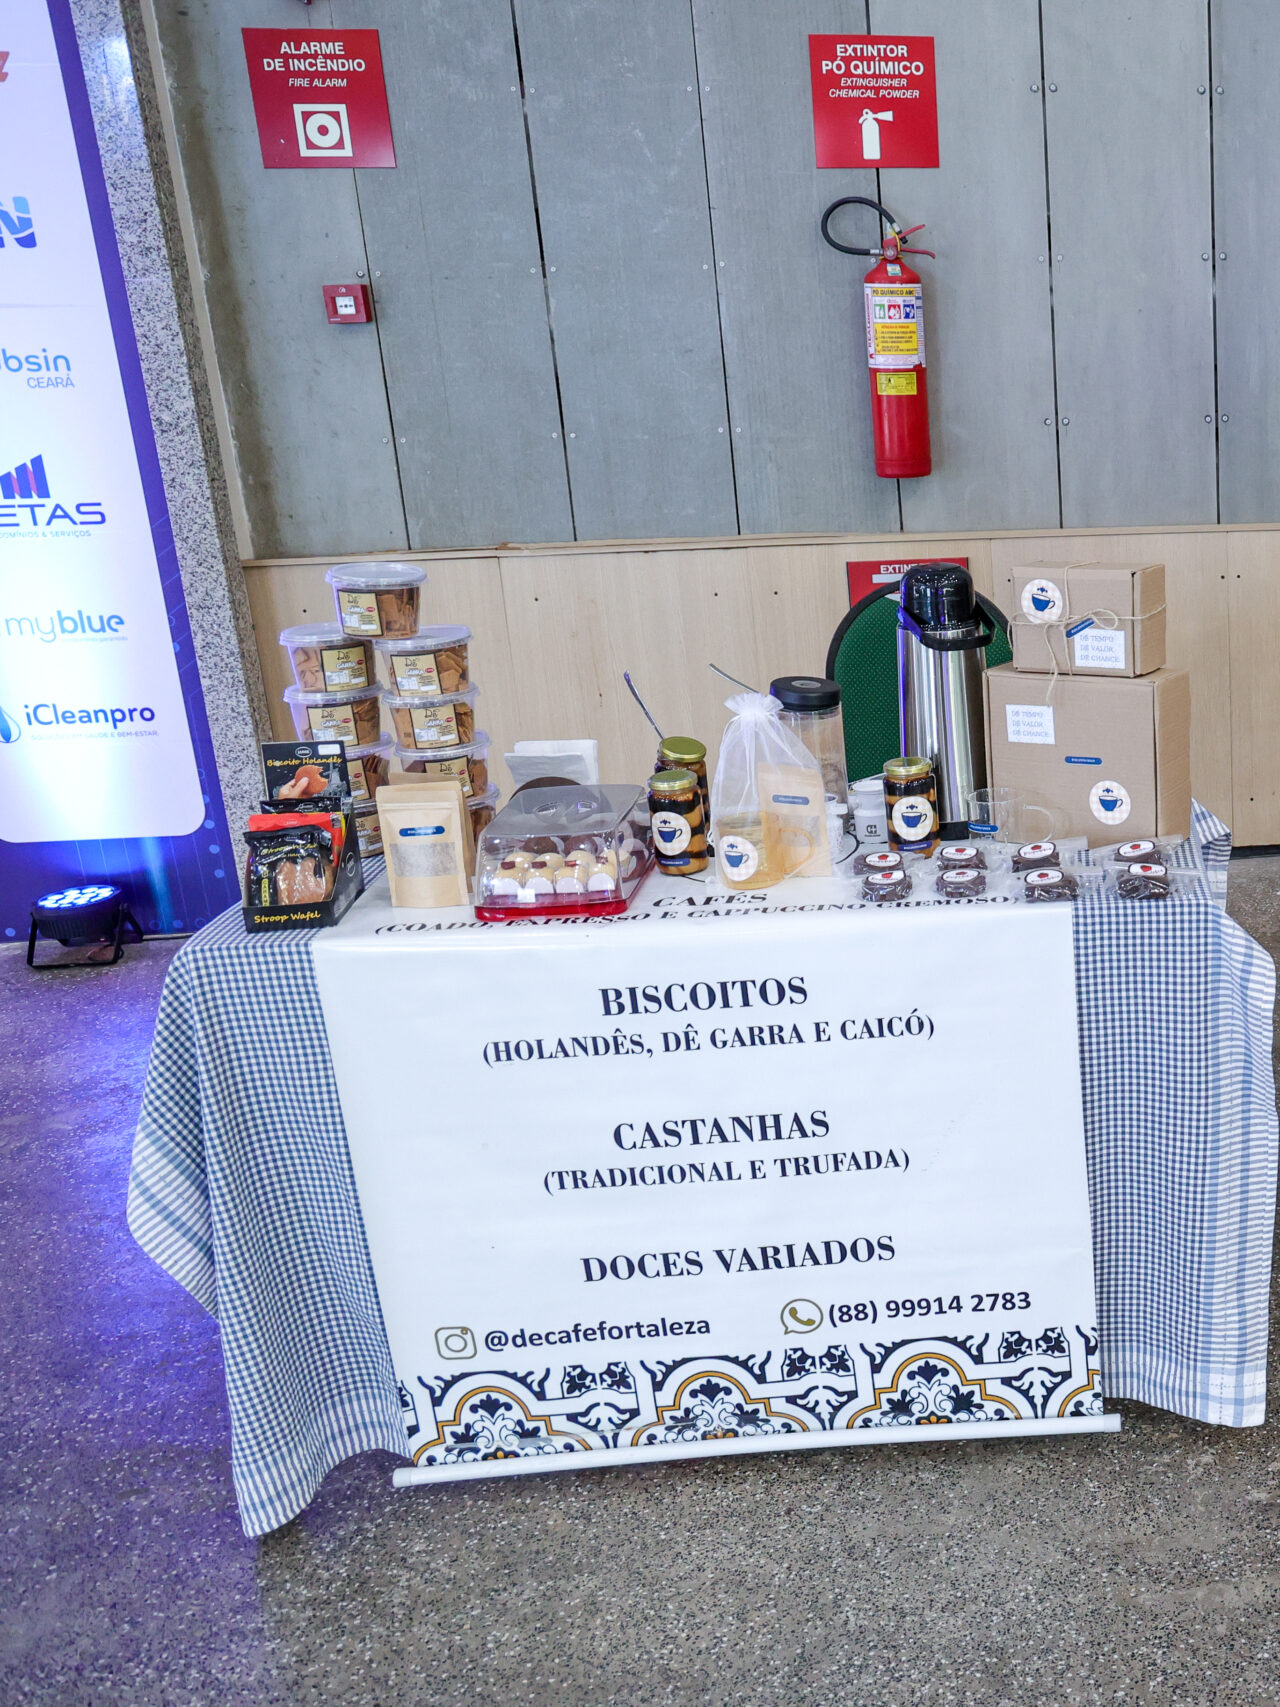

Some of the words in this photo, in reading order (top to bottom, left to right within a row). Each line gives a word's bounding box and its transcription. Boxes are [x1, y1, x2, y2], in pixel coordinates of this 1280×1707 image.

[280, 41, 345, 55] ALARME
[836, 44, 908, 58] EXTINTOR
[263, 58, 285, 71] DE
[289, 55, 366, 72] INCÊNDIO
[821, 57, 846, 75] PÓ
[850, 57, 924, 76] QUÍMICO
[288, 78, 310, 87] FIRE
[312, 78, 347, 87] ALARM
[840, 77, 907, 87] EXTINGUISHER
[829, 88, 877, 98] CHEMICAL
[879, 89, 920, 99] POWDER
[0, 348, 71, 372] bsin
[27, 373, 75, 389] CEARÁ
[4, 609, 125, 644] myblue
[23, 703, 156, 730] iCleanpro
[652, 891, 768, 907] CAFÉS
[254, 914, 289, 924] Stroop
[290, 910, 321, 921] Wafel
[660, 911, 678, 919] E
[598, 976, 807, 1016] BISCOITOS
[482, 1029, 654, 1068] (HOLANDÊS,
[661, 1023, 701, 1053] DÊ
[710, 1023, 806, 1050] GARRA
[812, 1021, 831, 1042] E
[840, 1008, 935, 1041] CAICÓ)
[613, 1110, 830, 1151] CASTANHAS
[543, 1160, 742, 1196] (TRADICIONAL
[748, 1159, 767, 1180] E
[774, 1148, 910, 1178] TRUFADA)
[580, 1250, 703, 1283] DOCES
[713, 1235, 895, 1274] VARIADOS
[484, 1317, 711, 1352] @decafefortaleza
[828, 1300, 878, 1328] (88)
[885, 1295, 963, 1318] 99914
[970, 1290, 1031, 1312] 2783
